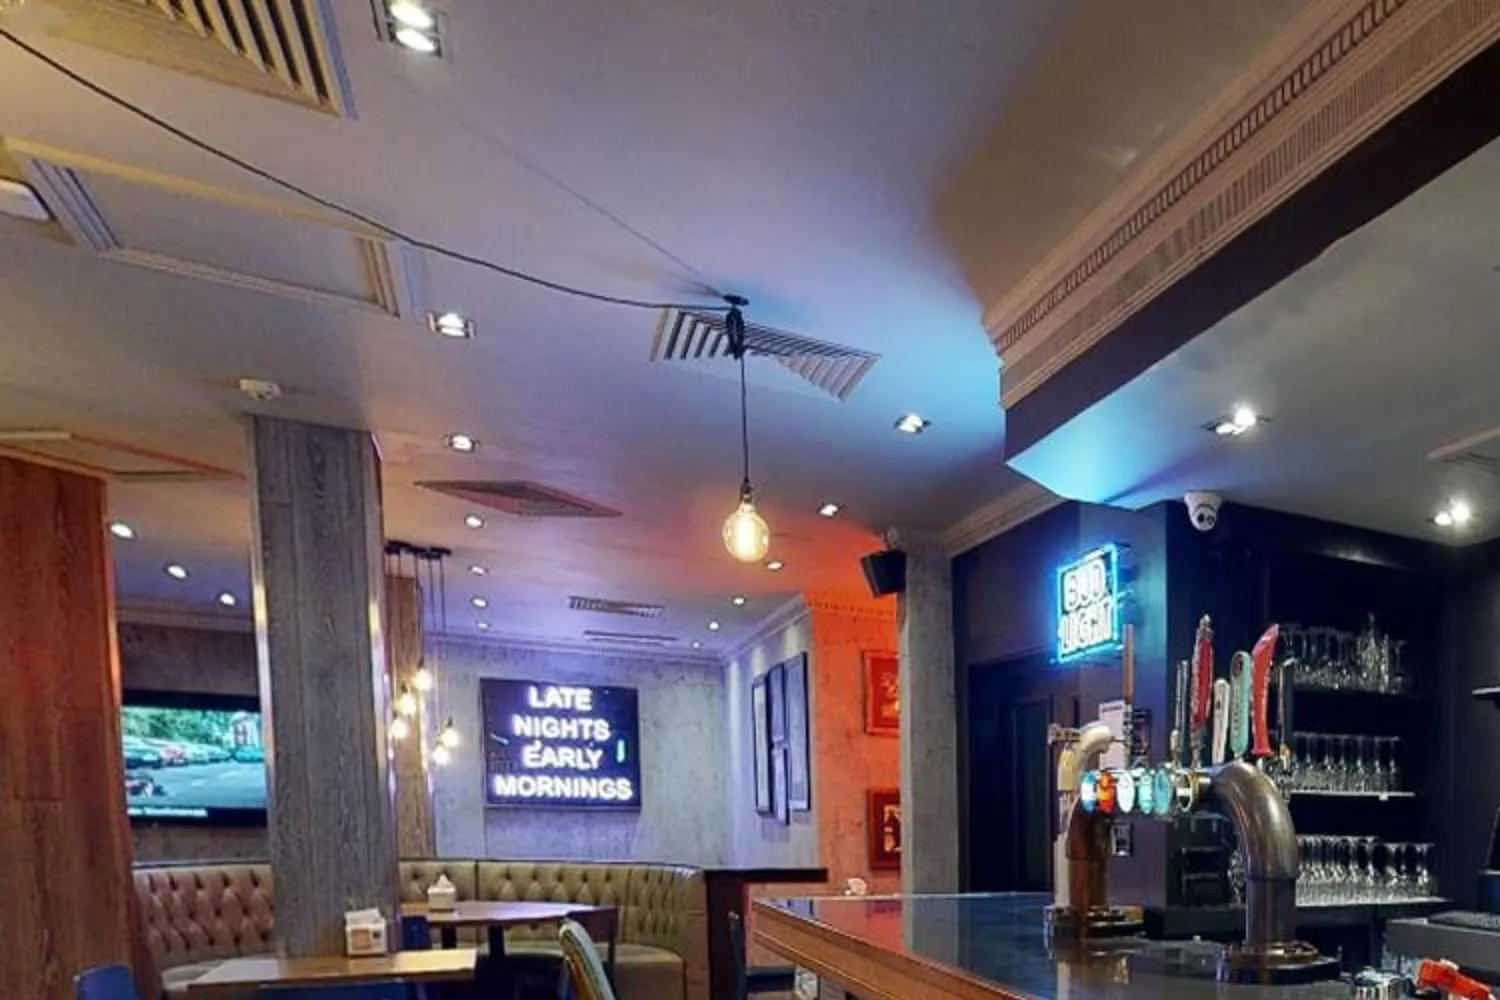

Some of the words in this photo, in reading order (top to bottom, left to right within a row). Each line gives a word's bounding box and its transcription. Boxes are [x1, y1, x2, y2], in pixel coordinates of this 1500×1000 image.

[528, 685, 593, 711] LATE
[511, 713, 611, 742] NIGHTS
[523, 742, 604, 770] EARLY
[493, 773, 633, 800] MORNINGS
